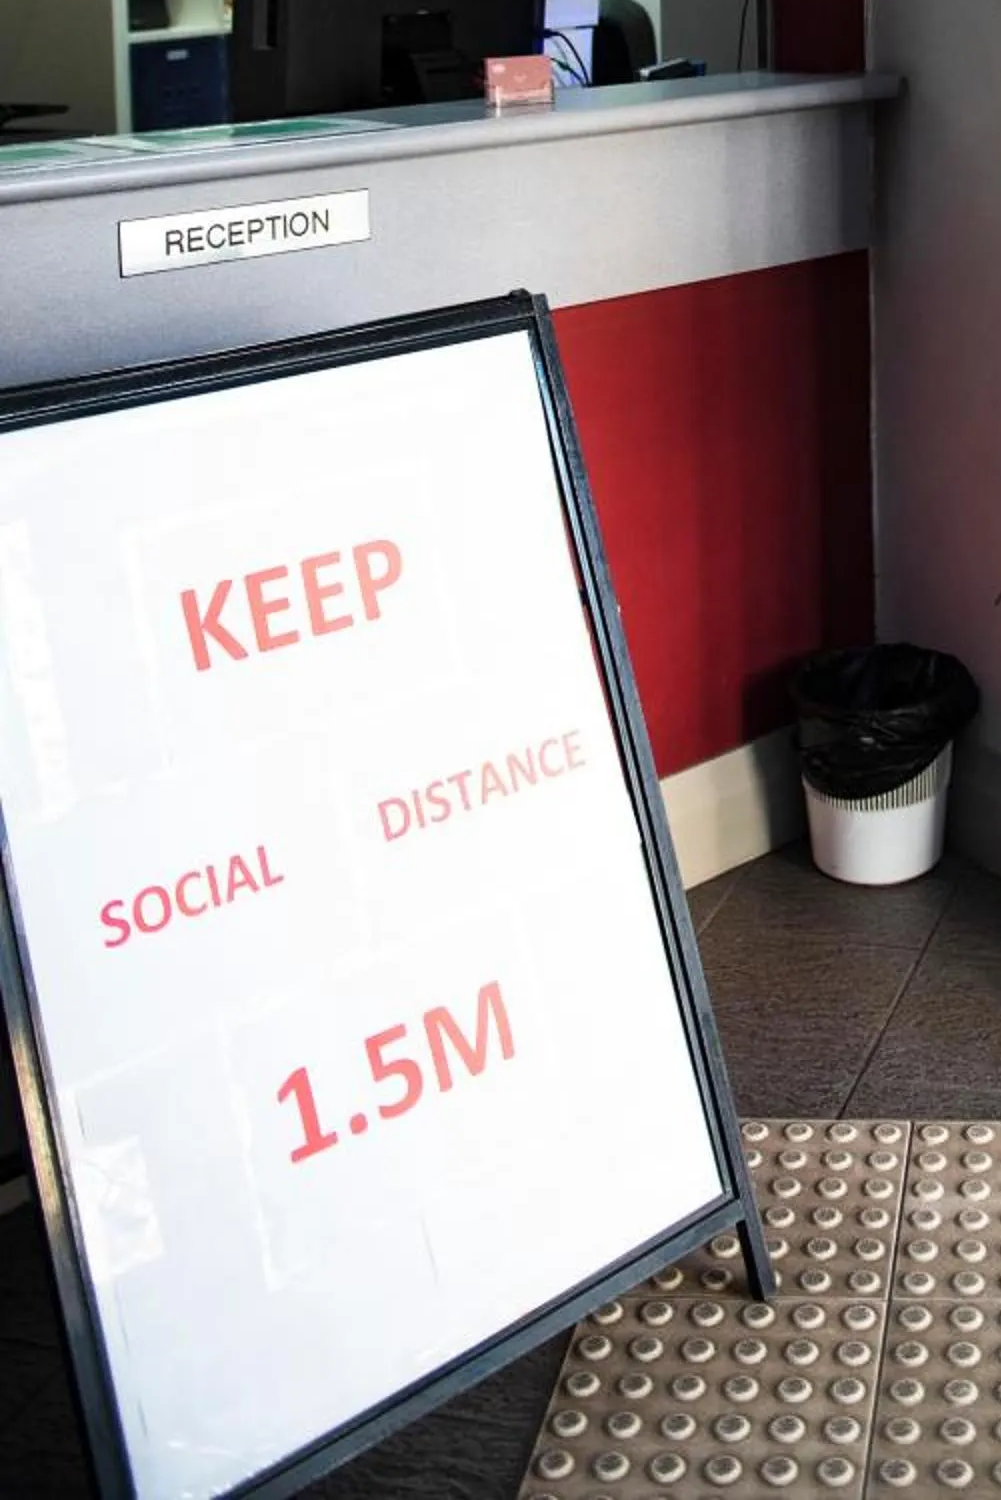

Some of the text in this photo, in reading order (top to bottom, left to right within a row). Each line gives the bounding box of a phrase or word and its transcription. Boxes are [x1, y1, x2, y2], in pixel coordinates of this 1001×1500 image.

[164, 208, 331, 257] RECEPTION
[179, 539, 404, 673] KEEP
[99, 729, 588, 949] SOCIAL DISTANCE
[275, 980, 517, 1163] 1.5M
